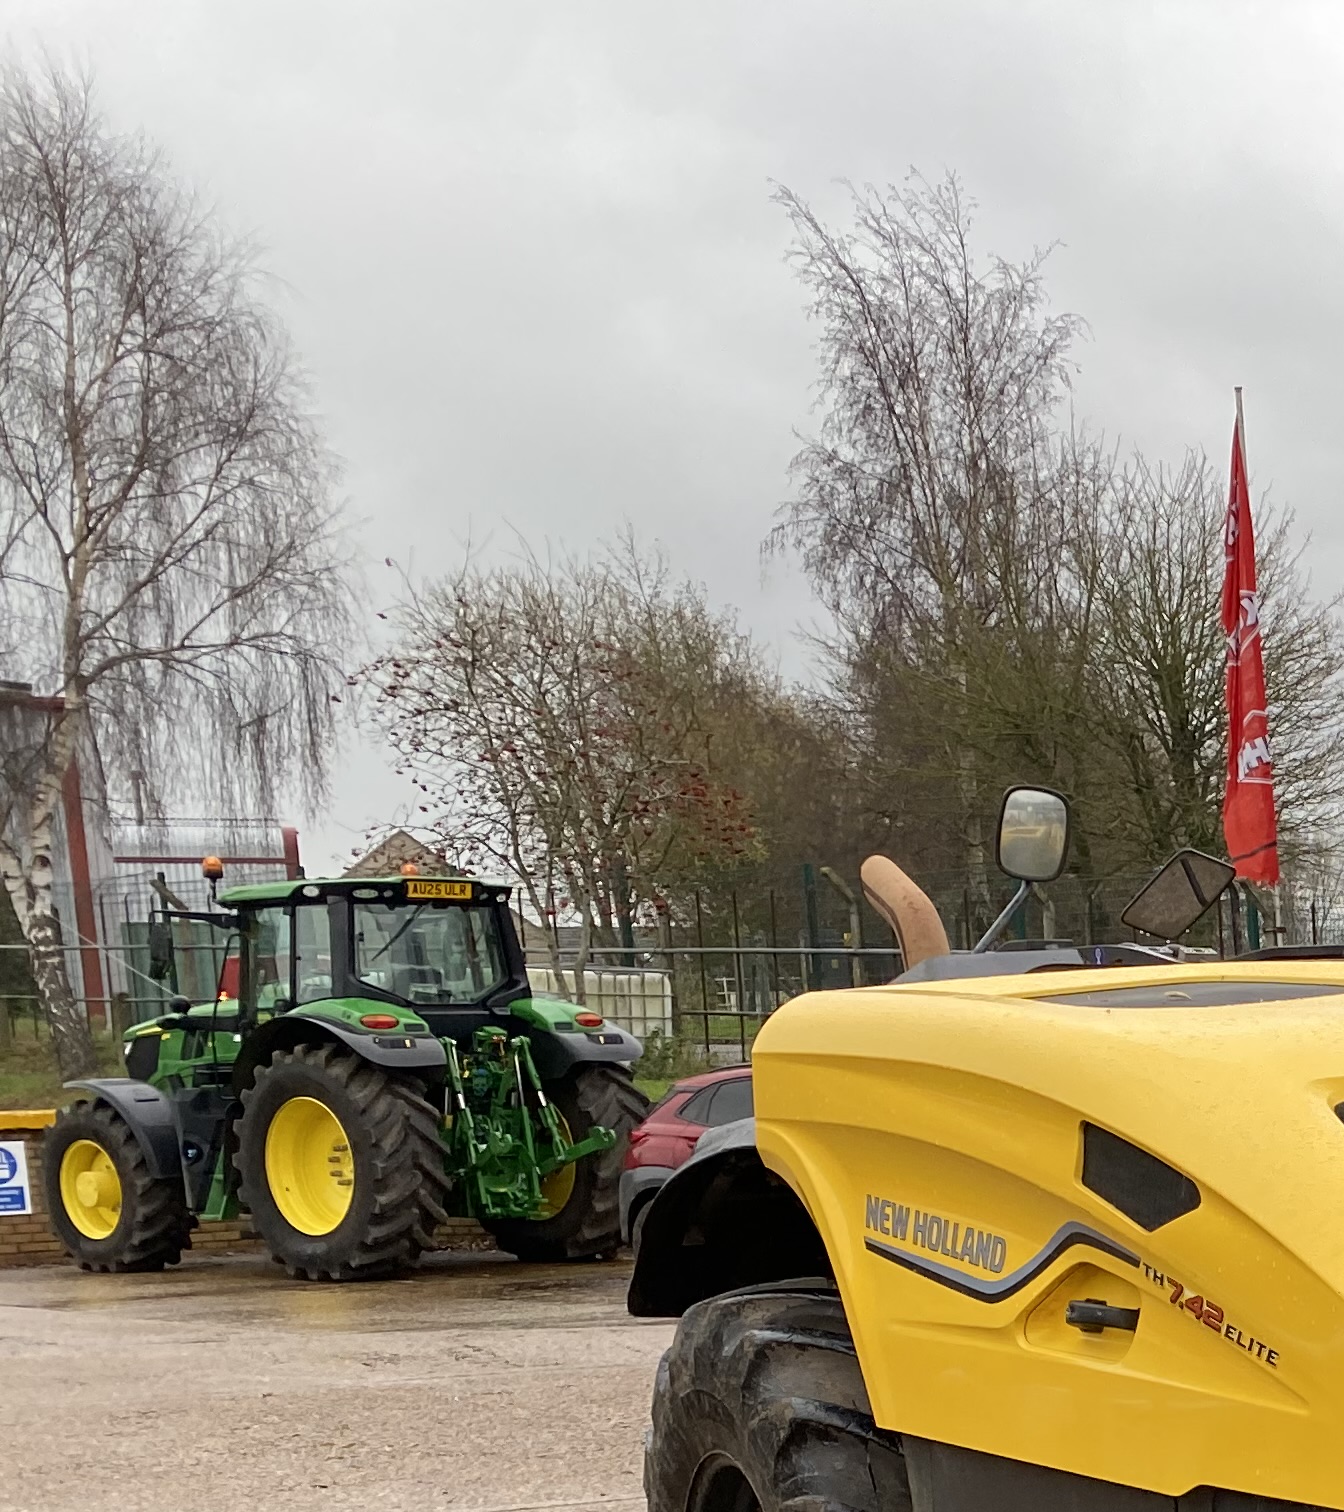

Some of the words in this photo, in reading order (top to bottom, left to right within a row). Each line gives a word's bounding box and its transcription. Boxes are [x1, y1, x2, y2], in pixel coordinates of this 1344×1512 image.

[411, 883, 441, 895] AU25
[444, 884, 467, 896] ULR
[865, 1193, 911, 1242] NEW
[912, 1209, 1007, 1274] HOLLAND
[1223, 1323, 1280, 1367] ELITE
